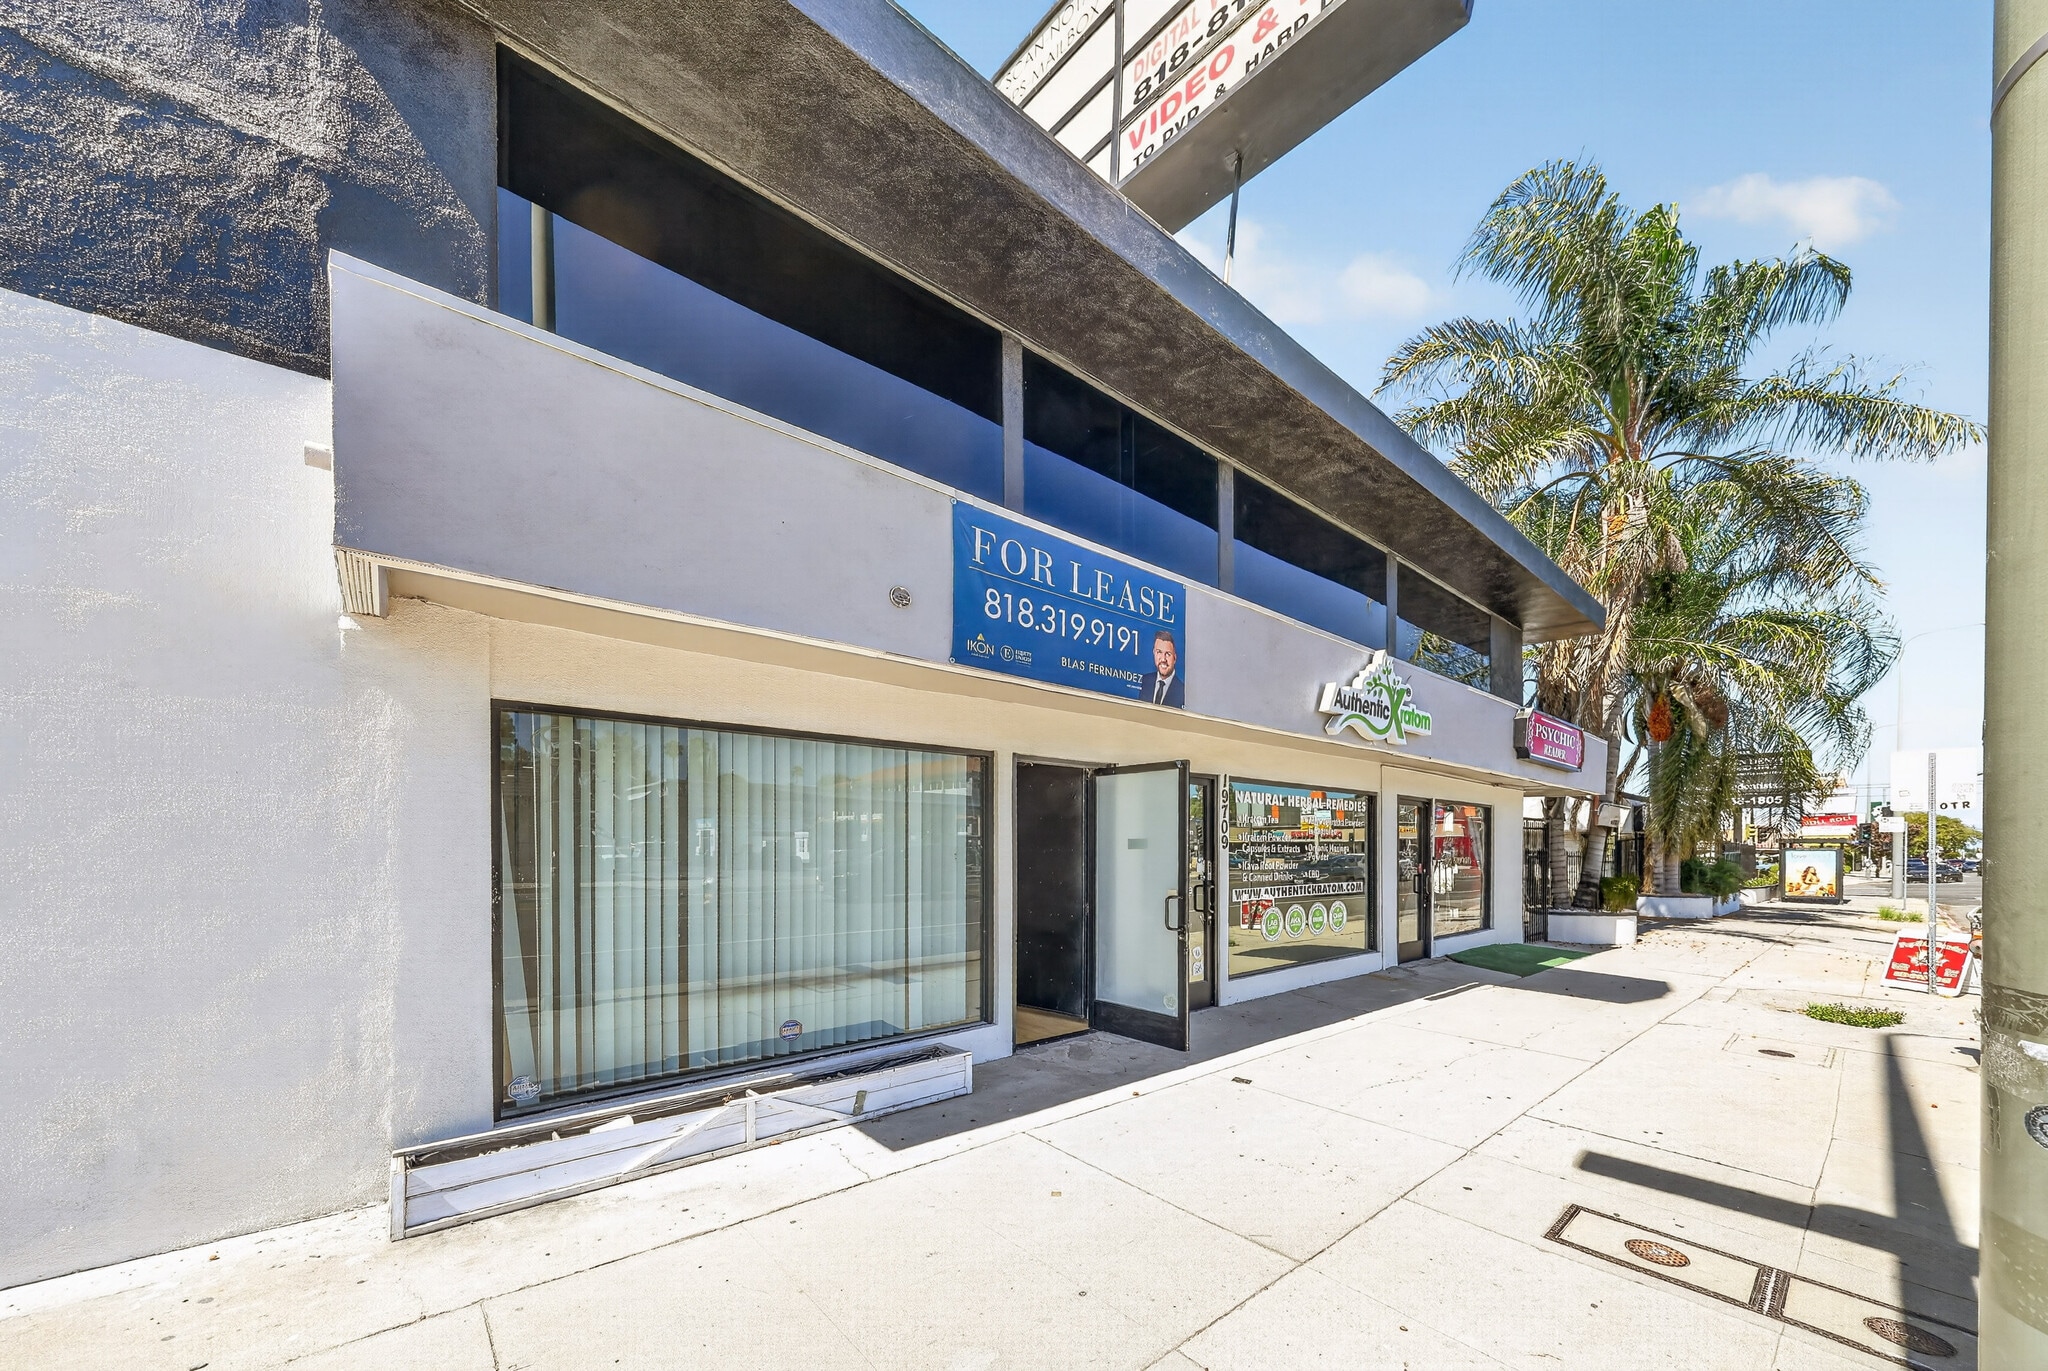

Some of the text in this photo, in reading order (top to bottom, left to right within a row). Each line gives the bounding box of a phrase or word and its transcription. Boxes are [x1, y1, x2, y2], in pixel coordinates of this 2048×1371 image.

[1133, 6, 1200, 84] DIGITAL
[1133, 0, 1254, 105] 818-81
[1128, 7, 1280, 150] VIDEO &
[1133, 13, 1310, 166] TO DVD & HARD
[971, 525, 1175, 624] FOR LEASE
[984, 587, 1139, 656] 818.319.9191
[967, 639, 995, 656] IKON
[1061, 656, 1144, 684] BLAS FERNANDEZ
[1334, 687, 1390, 720] Authentic
[1535, 723, 1576, 749] PSYCHIC
[1543, 744, 1567, 760] READER
[1234, 790, 1367, 812] NATURAL HERBAL REMEDIES
